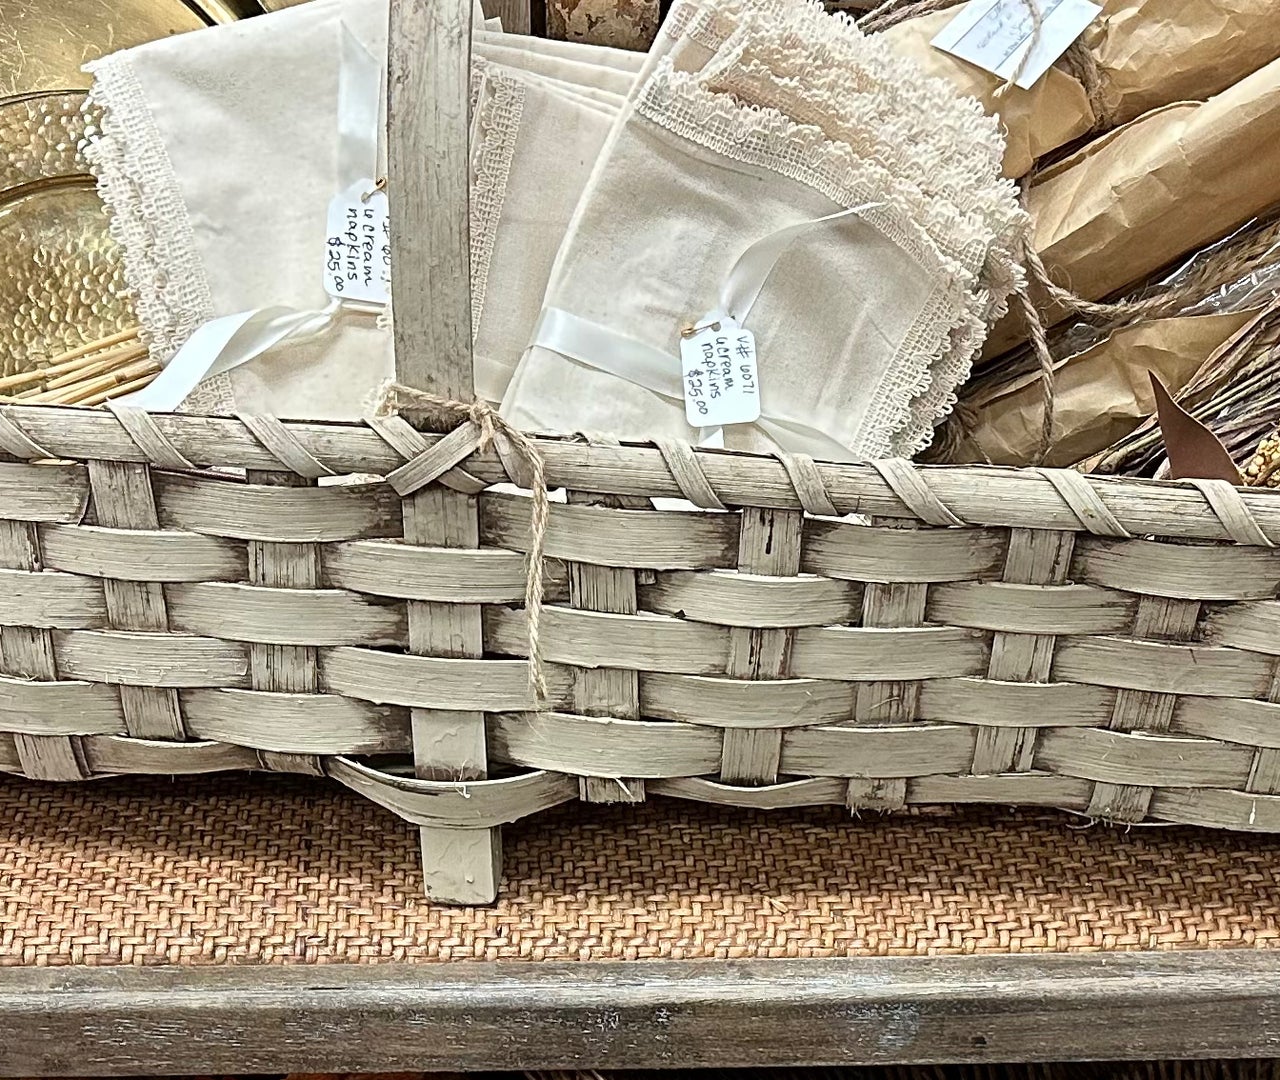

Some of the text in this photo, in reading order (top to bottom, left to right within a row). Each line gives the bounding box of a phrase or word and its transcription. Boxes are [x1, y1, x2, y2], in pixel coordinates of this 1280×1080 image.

[344, 208, 360, 281] napkins
[701, 342, 721, 399] napkins
[740, 364, 755, 394] 6071
